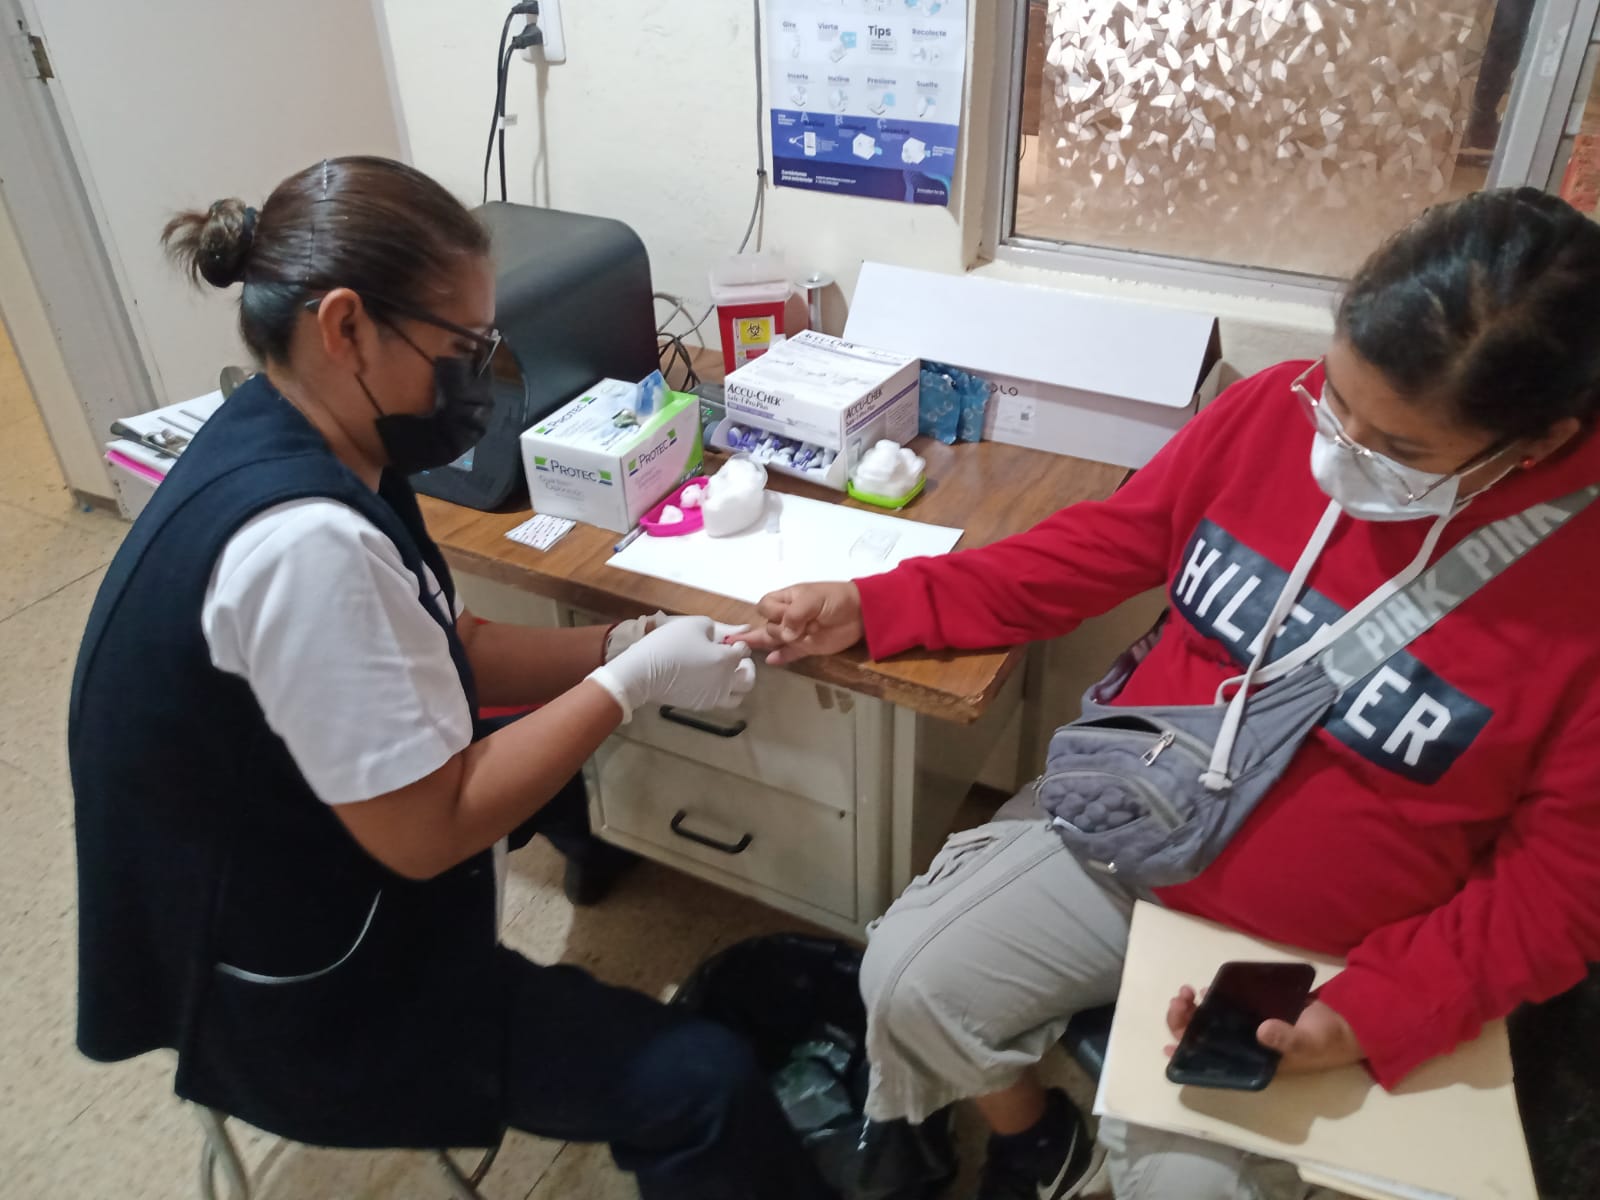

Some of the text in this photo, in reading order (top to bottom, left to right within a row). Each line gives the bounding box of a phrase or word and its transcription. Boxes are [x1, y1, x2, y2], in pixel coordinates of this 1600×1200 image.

[868, 25, 891, 39] Tips
[800, 111, 810, 123] A
[835, 114, 844, 126] B
[727, 383, 782, 407] ACCU-CHEK
[846, 388, 882, 419] ACCU-CHEK
[639, 440, 669, 470] PROTEC
[550, 459, 597, 482] PROTEC
[1457, 503, 1571, 580] PINK
[1355, 570, 1462, 661] PINK
